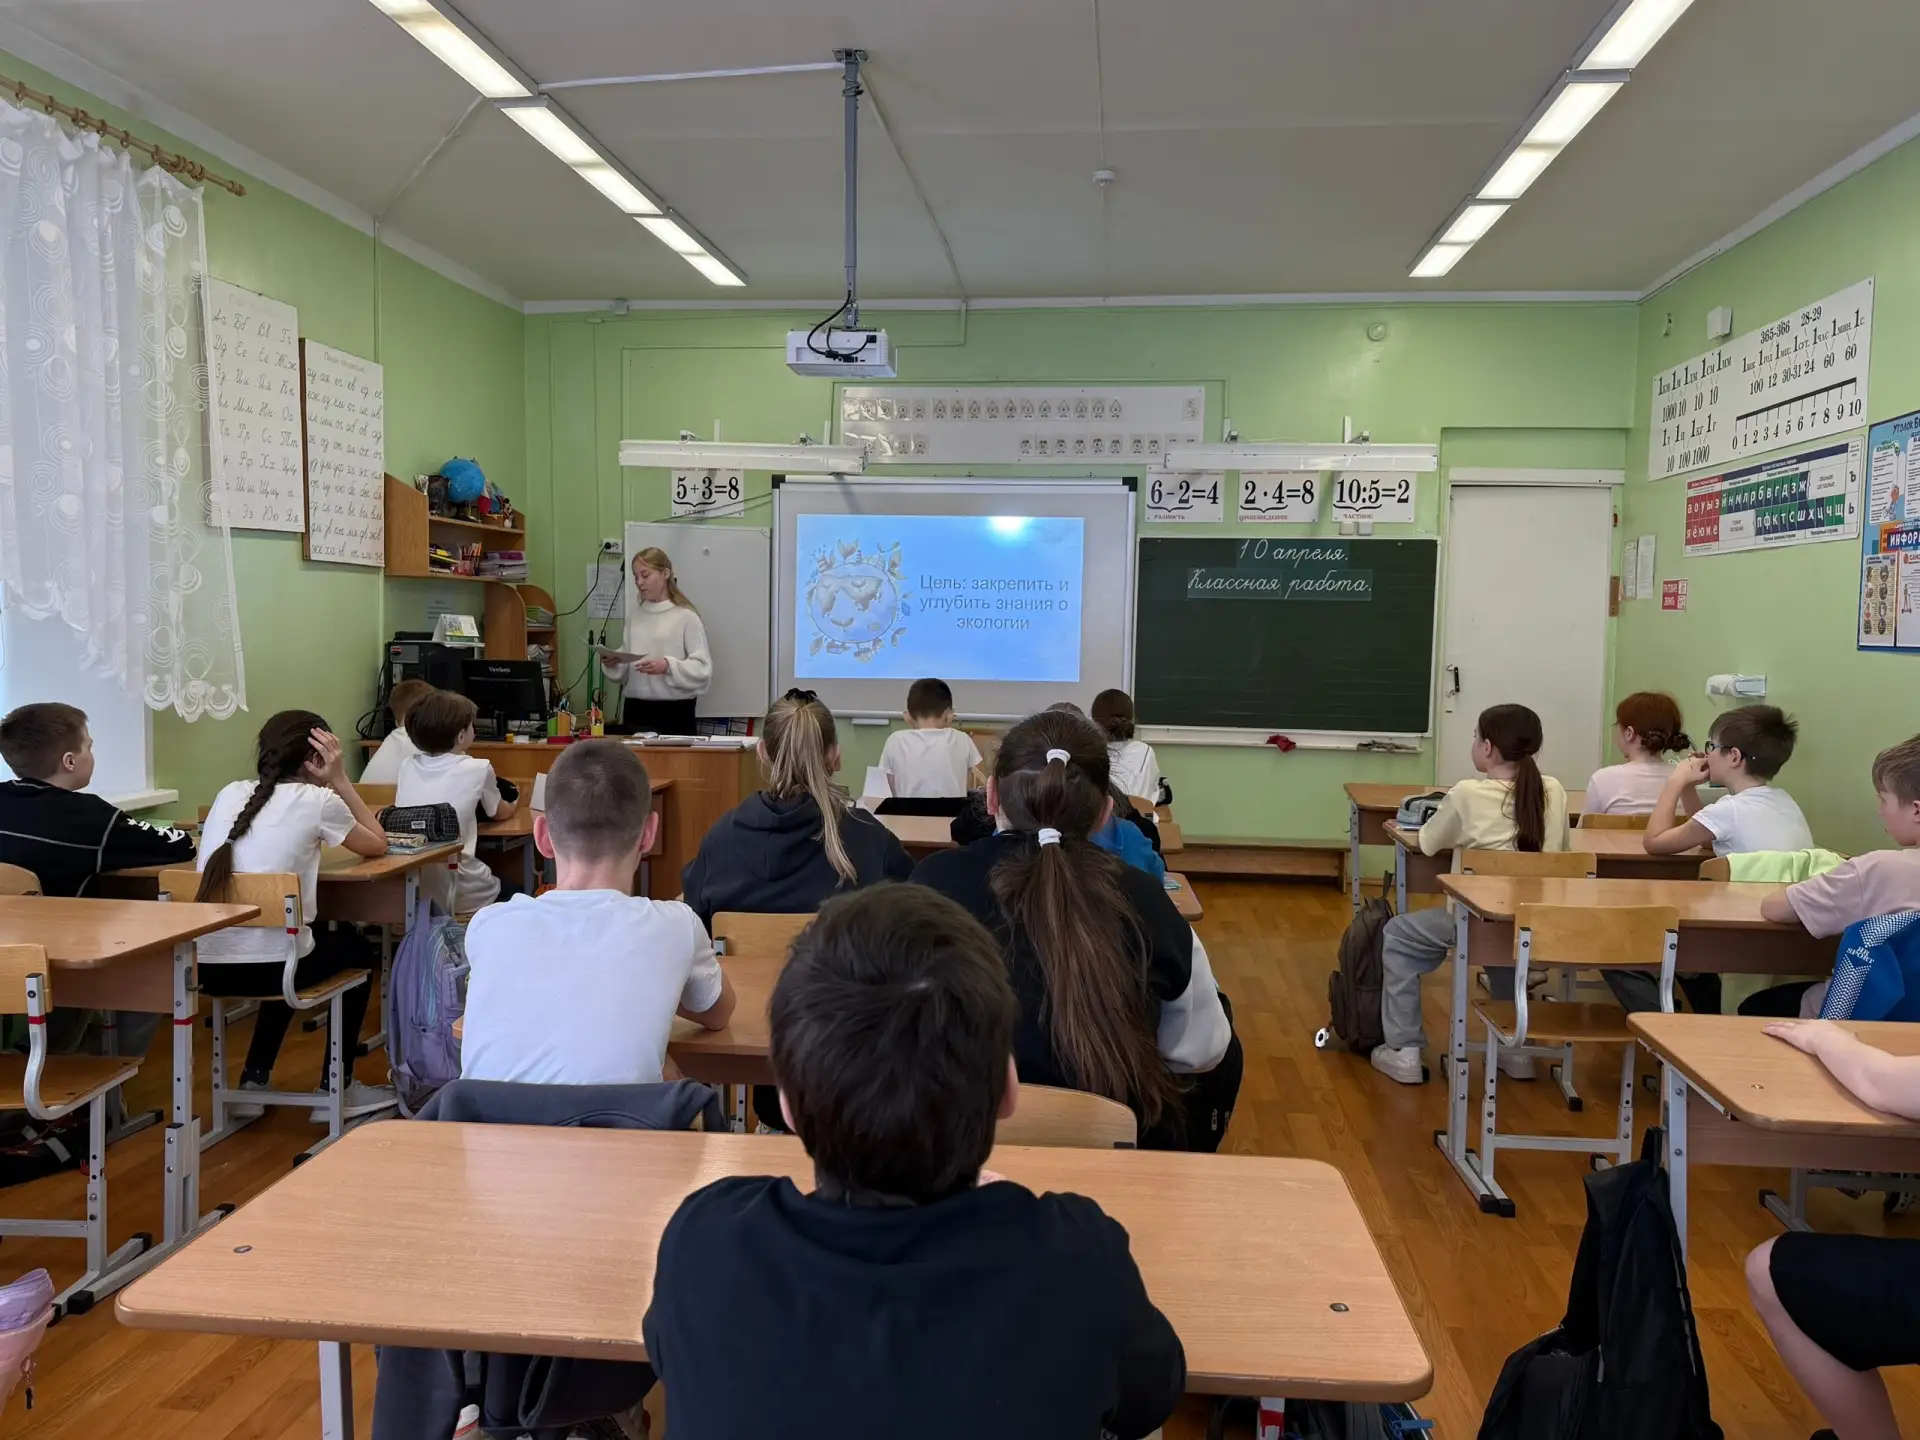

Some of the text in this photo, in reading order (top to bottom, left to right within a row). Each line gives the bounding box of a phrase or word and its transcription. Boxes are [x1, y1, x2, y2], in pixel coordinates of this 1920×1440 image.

[1800, 306, 1822, 327] 28-29
[1760, 320, 1791, 345] 365-366
[1749, 343, 1857, 395] 100 12 30-31 24 60 60
[1678, 398, 1687, 417] 10
[1694, 392, 1703, 411] 10
[1709, 386, 1719, 406] 10
[1732, 398, 1862, 450] 0 1 2 3 4 5 6 7 8 9 10
[1666, 455, 1675, 473] 10
[1692, 444, 1710, 466] 1000
[1336, 478, 1410, 504] 10:5=2
[1273, 546, 1349, 568] апреля.
[919, 575, 1070, 594] Цель: закрепить и
[1187, 568, 1373, 599] Классная работа.
[919, 595, 1068, 612] углубить знания о
[956, 616, 1031, 630] экологии
[1846, 947, 1875, 964] SPORT
